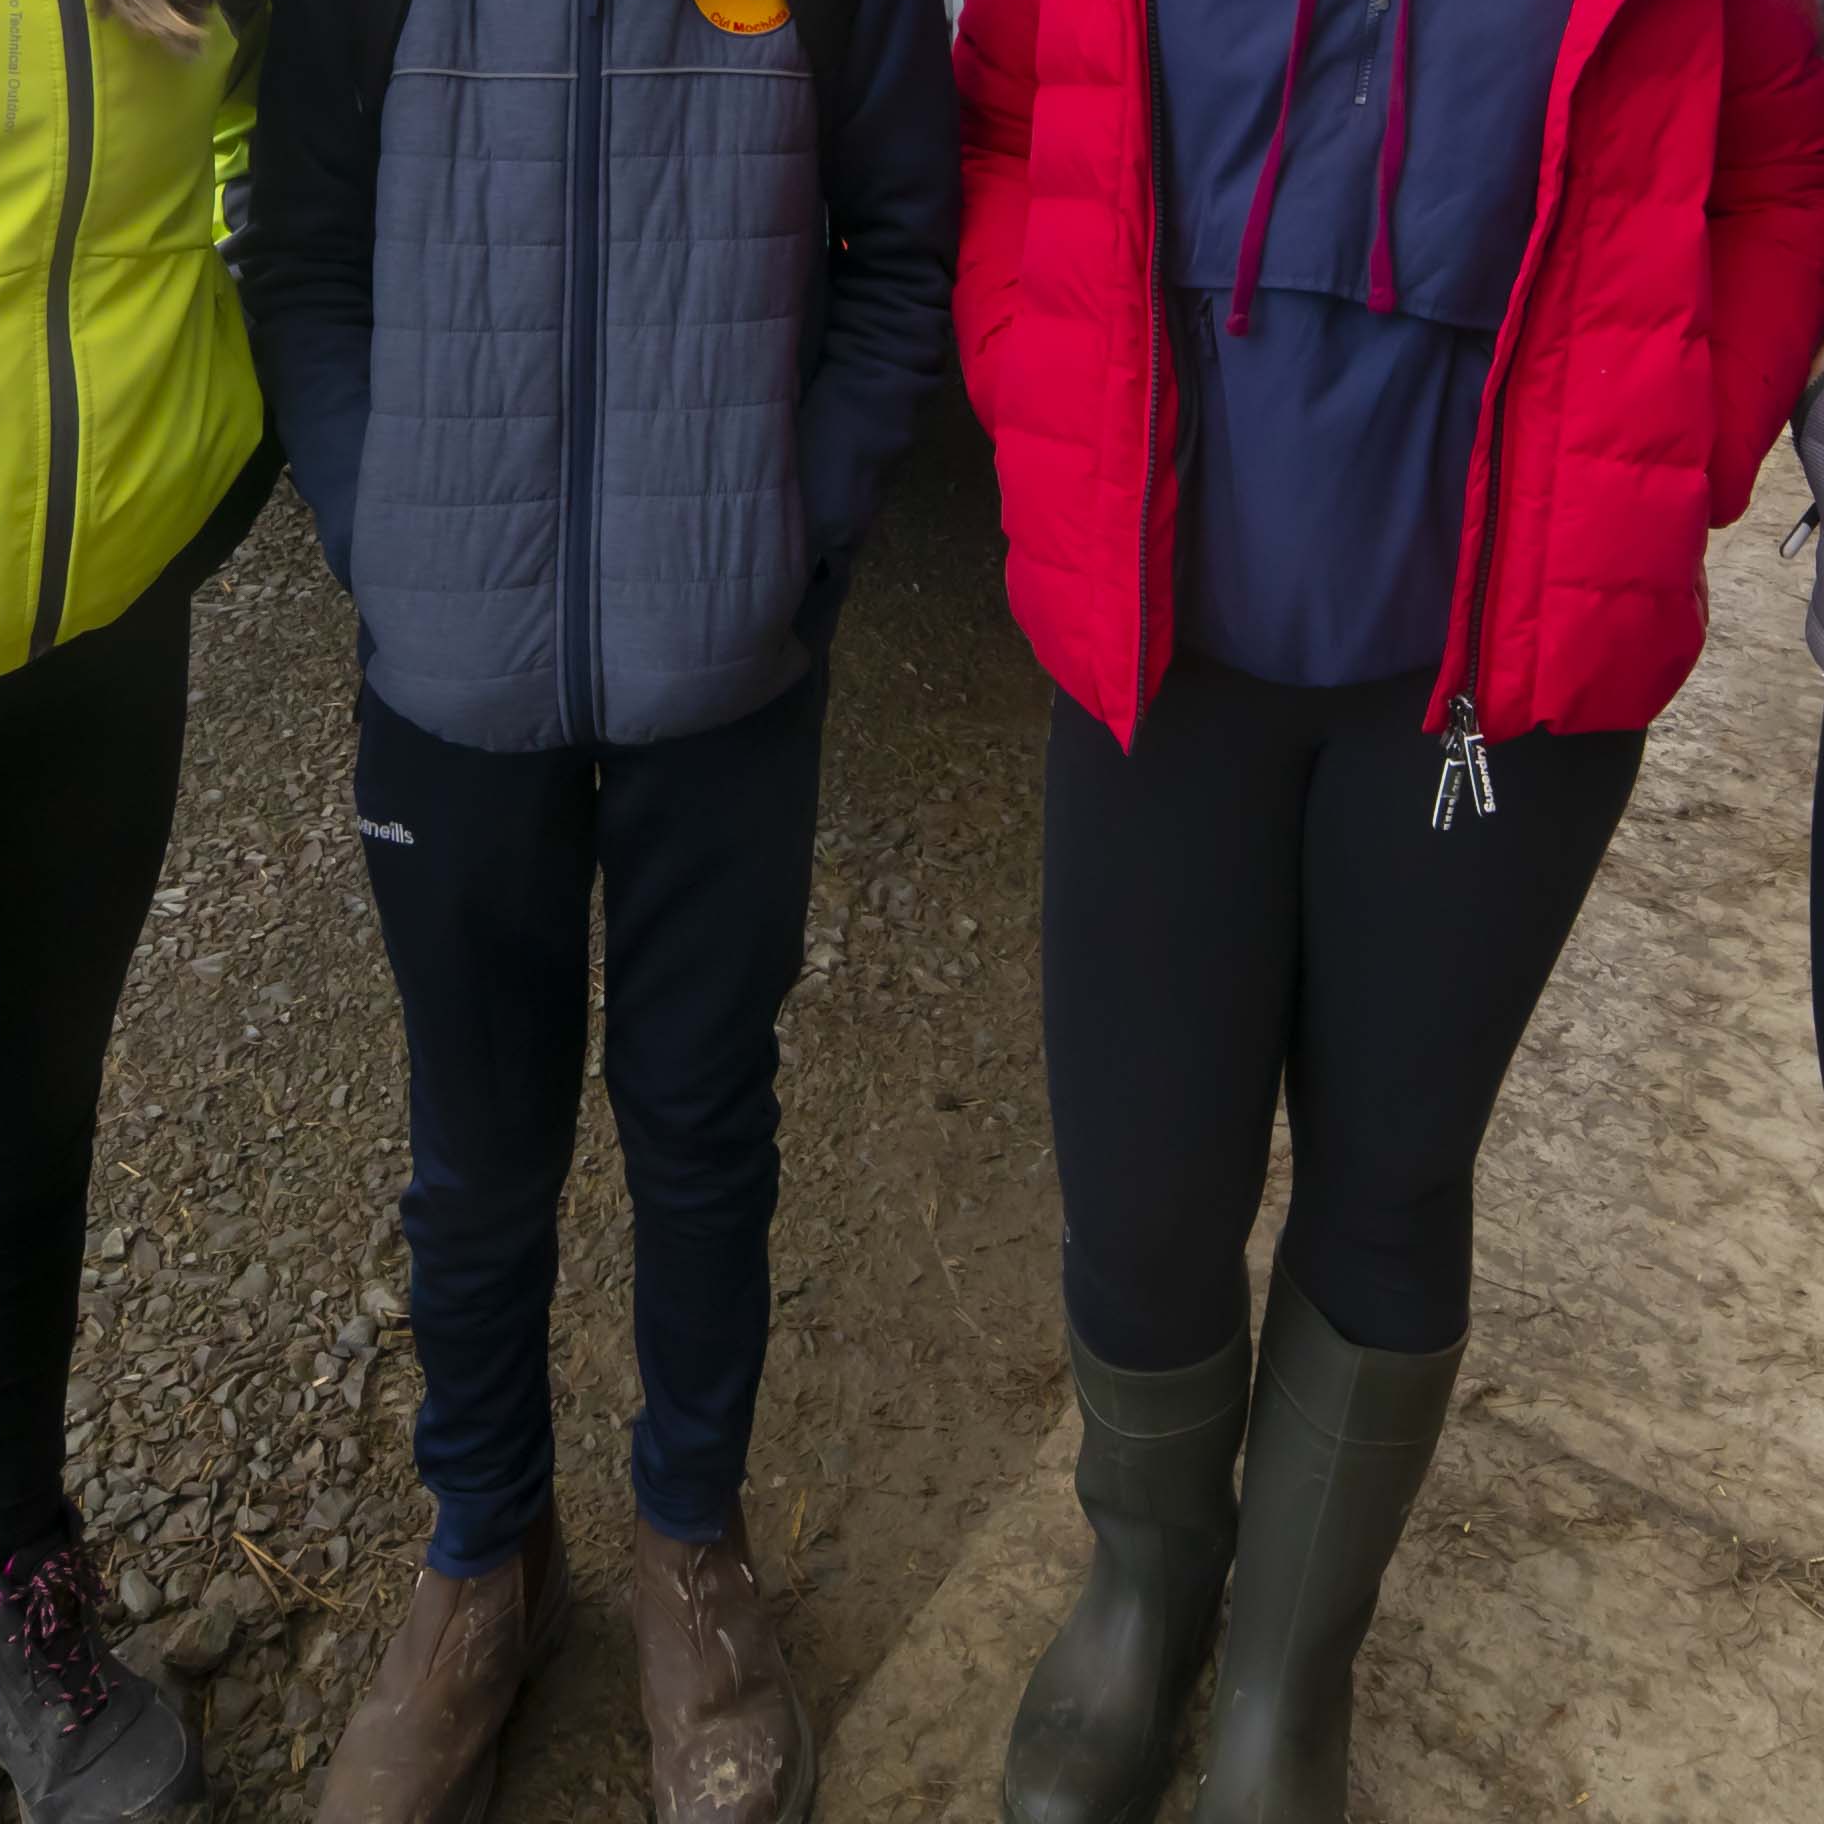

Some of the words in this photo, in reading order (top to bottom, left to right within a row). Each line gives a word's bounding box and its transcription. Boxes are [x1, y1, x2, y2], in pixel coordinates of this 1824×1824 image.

[8, 11, 23, 74] Technical
[4, 78, 20, 134] Outdoor
[1475, 744, 1496, 813] Superdry
